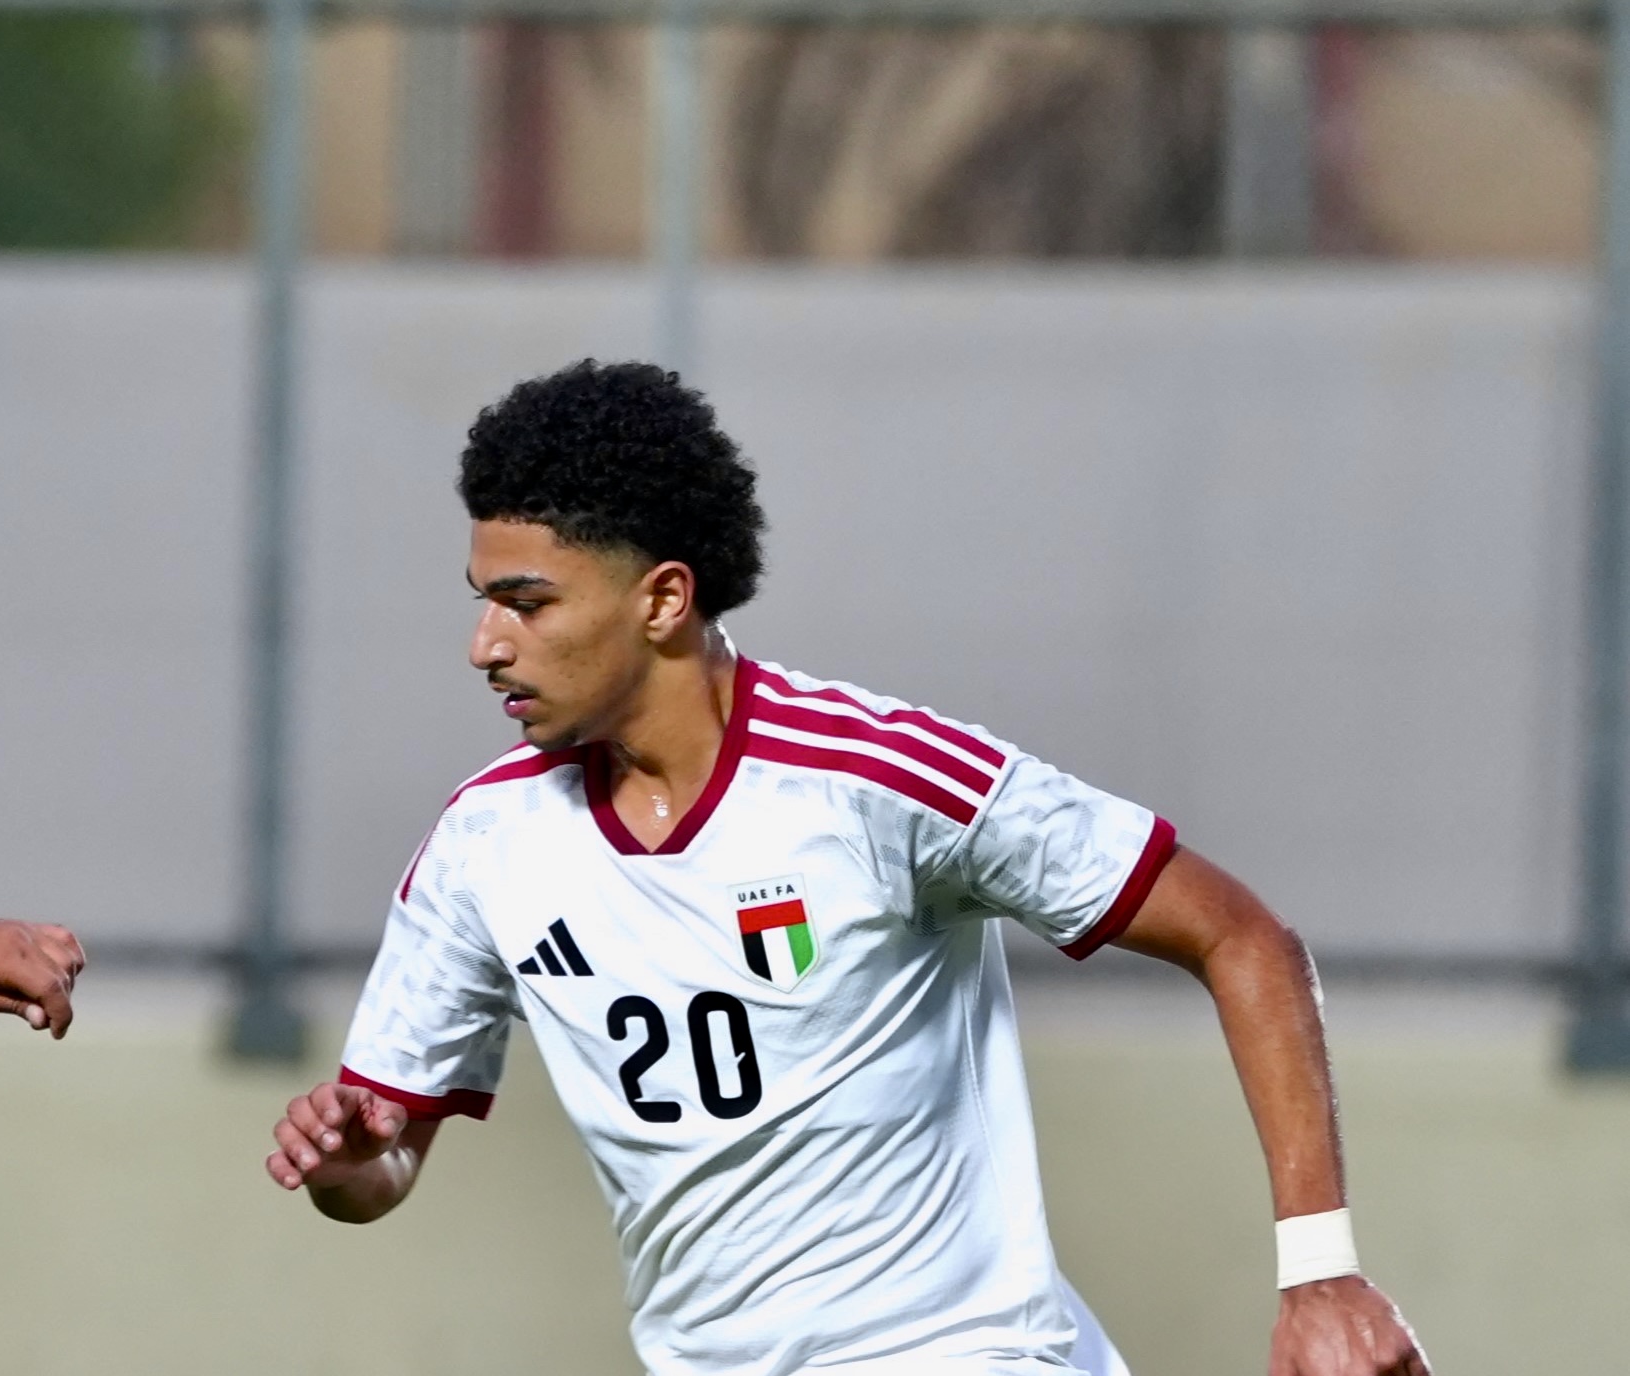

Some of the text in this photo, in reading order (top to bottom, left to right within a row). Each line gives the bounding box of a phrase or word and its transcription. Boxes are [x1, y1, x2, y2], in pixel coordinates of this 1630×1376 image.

[738, 884, 795, 903] UAE FA
[606, 990, 762, 1123] 20
